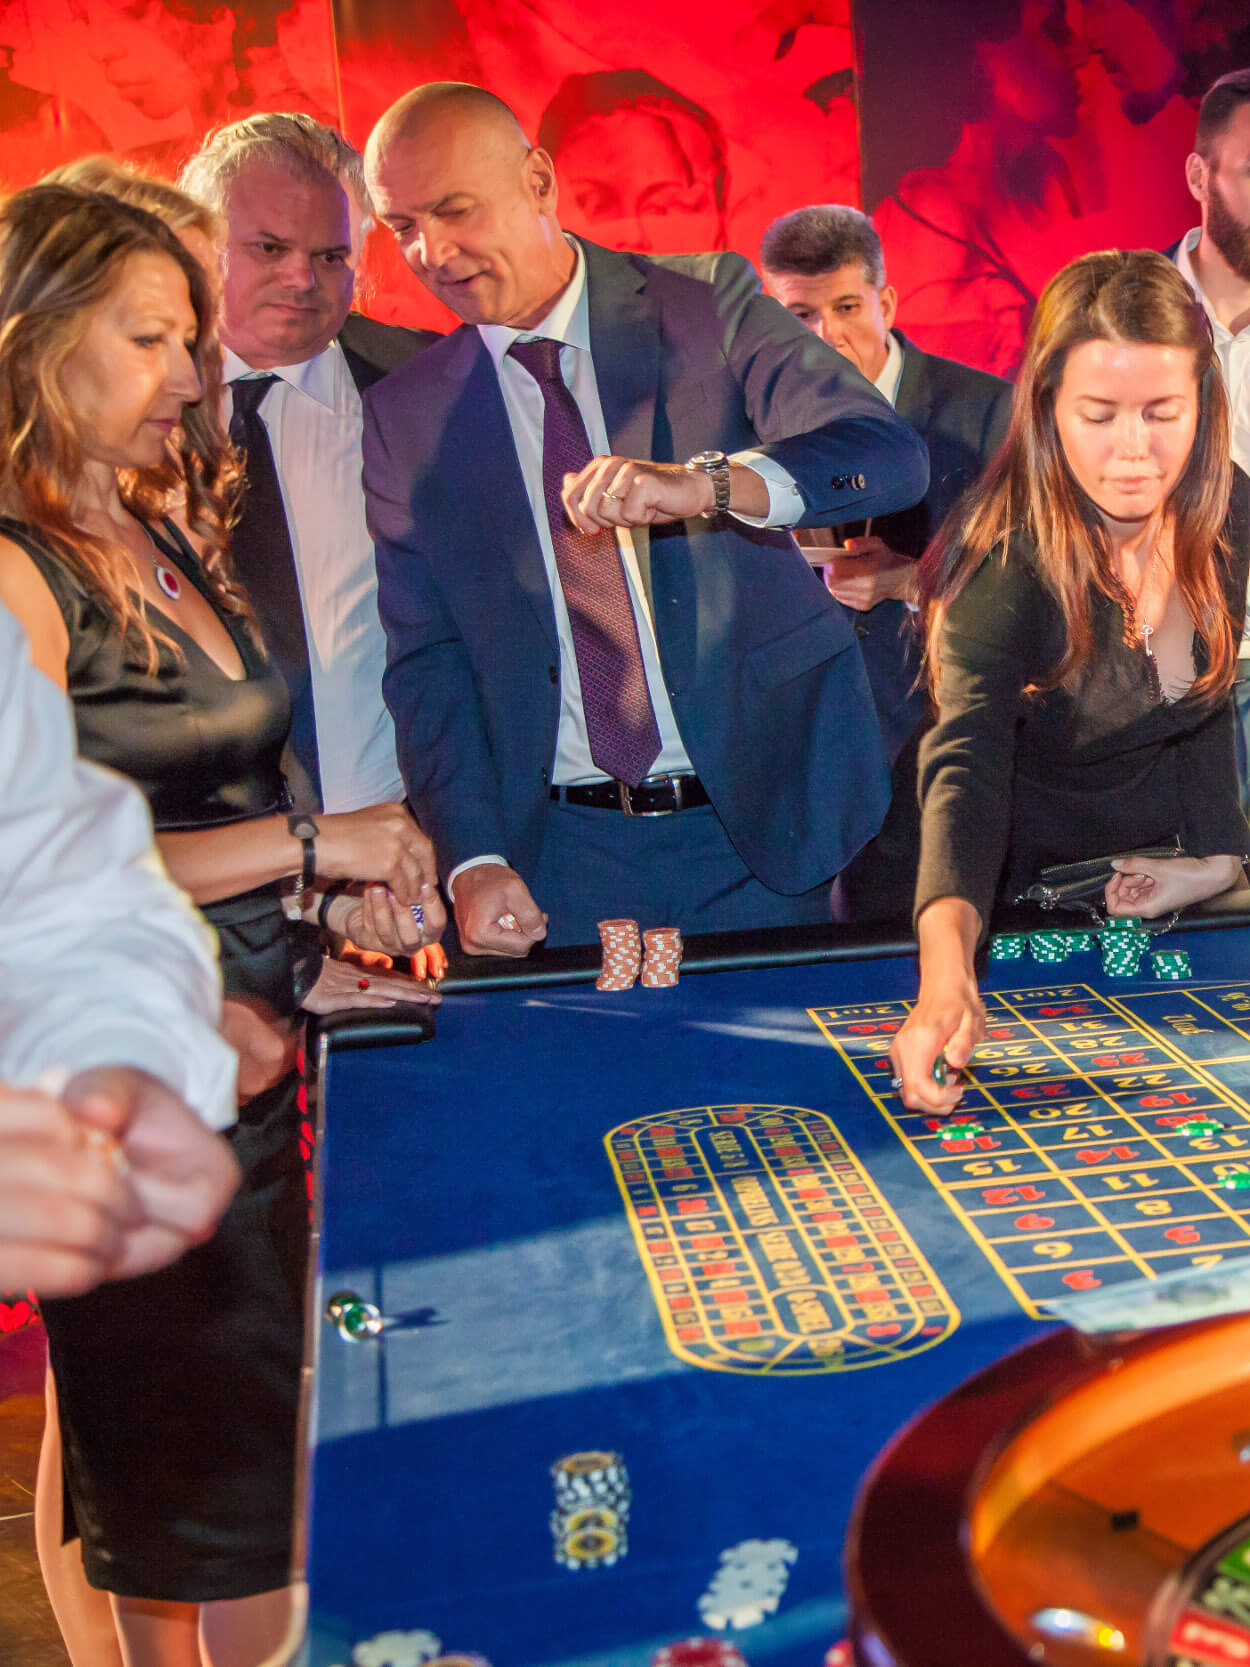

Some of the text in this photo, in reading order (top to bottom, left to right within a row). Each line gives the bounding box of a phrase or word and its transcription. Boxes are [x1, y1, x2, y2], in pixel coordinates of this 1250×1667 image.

[1038, 1004, 1093, 1016] 34
[1059, 1020, 1108, 1032] 31
[1069, 1035, 1127, 1049] 28
[974, 1045, 1032, 1059] 29
[1091, 1052, 1150, 1067] 25
[989, 1062, 1051, 1077] 26
[1113, 1073, 1172, 1088] 22
[1011, 1084, 1070, 1099] 23
[1139, 1092, 1197, 1108] 19
[1029, 1103, 1092, 1119] 20
[1063, 1124, 1113, 1140] 17
[1189, 1134, 1249, 1150] 13
[1075, 1146, 1140, 1164] 14
[962, 1159, 1022, 1176] 15
[1102, 1172, 1160, 1191] 11
[981, 1185, 1046, 1204] 12
[1135, 1199, 1173, 1216] 8
[1014, 1213, 1055, 1230] 9
[1164, 1225, 1200, 1244] 5
[1033, 1241, 1073, 1259] 6
[1062, 1269, 1102, 1291] 3
